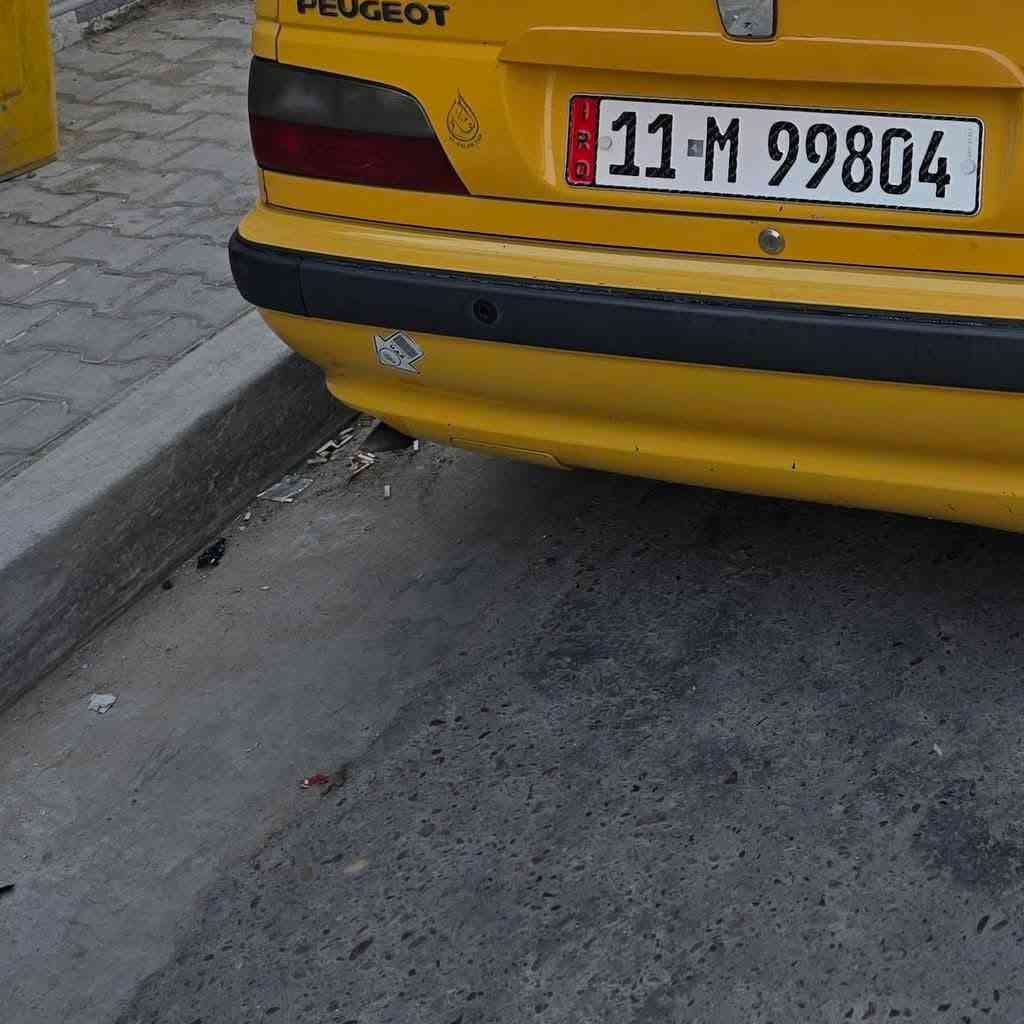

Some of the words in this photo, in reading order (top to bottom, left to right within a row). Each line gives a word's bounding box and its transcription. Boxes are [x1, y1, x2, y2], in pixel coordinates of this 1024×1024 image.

[609, 111, 677, 180] 11
[703, 116, 740, 184] M
[767, 120, 951, 199] 99804
